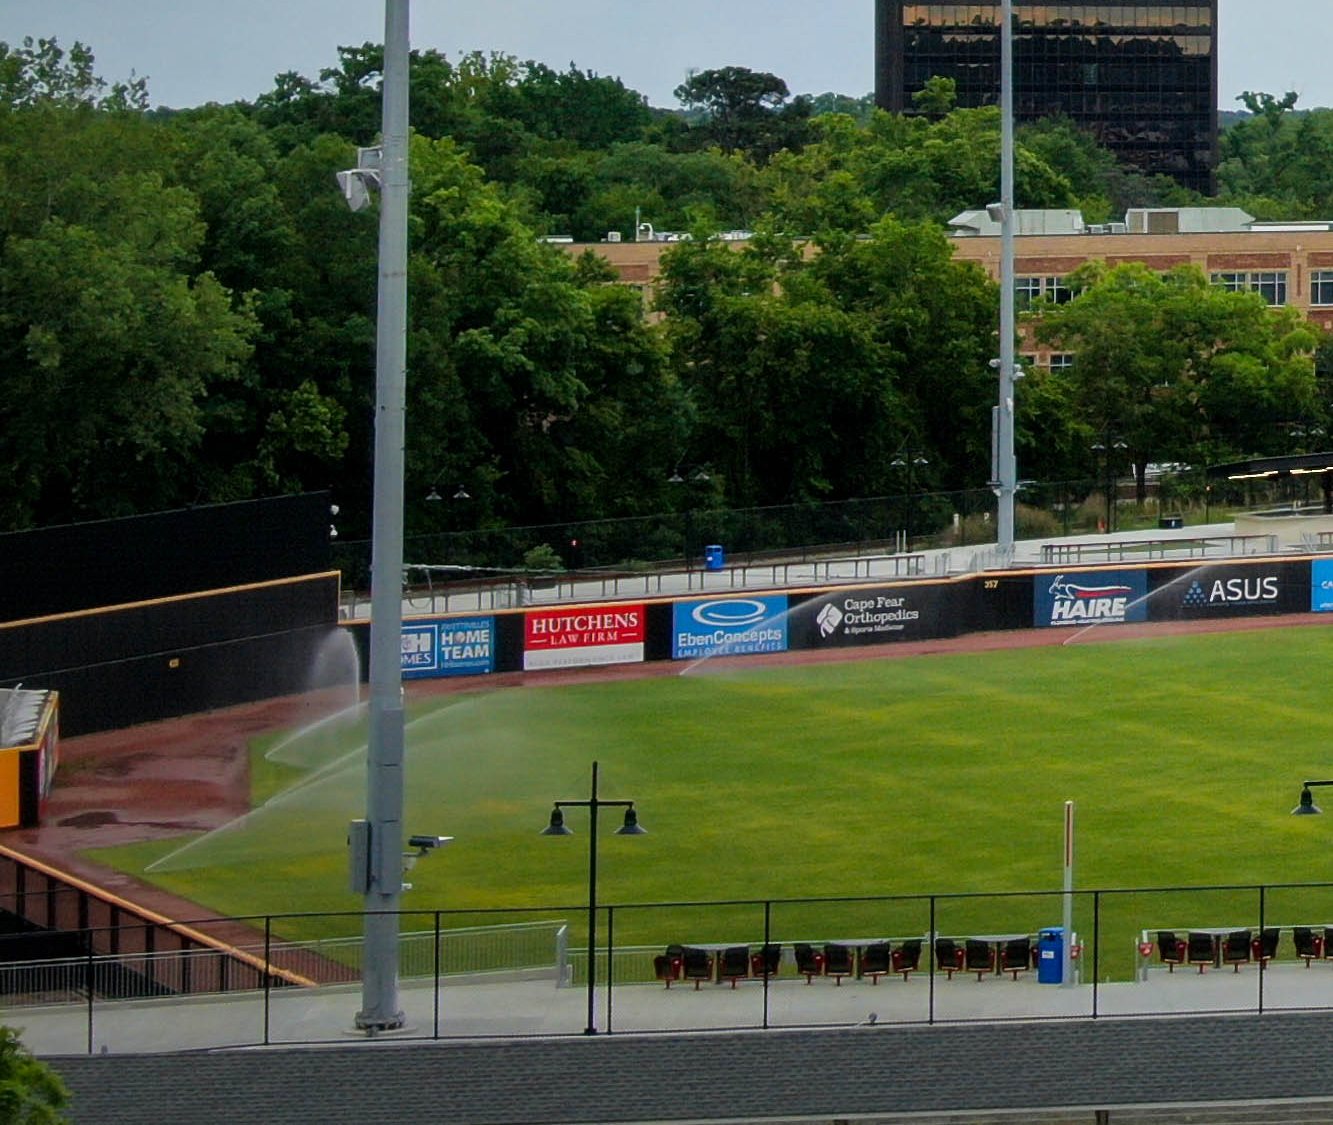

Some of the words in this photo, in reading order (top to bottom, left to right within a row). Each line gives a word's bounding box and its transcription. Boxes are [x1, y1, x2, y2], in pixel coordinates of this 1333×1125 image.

[1209, 577, 1278, 602] ASUS
[844, 598, 875, 611] Cape
[876, 596, 905, 608] Fear
[1051, 597, 1127, 620] HAIRE
[532, 612, 638, 634] HUTCHENS
[844, 609, 919, 625] Orthopedics
[441, 630, 490, 645] HOME
[551, 633, 579, 645] LAW
[583, 631, 618, 643] FIRM
[678, 629, 782, 647] EbenConcepts
[441, 644, 490, 660] TEAM
